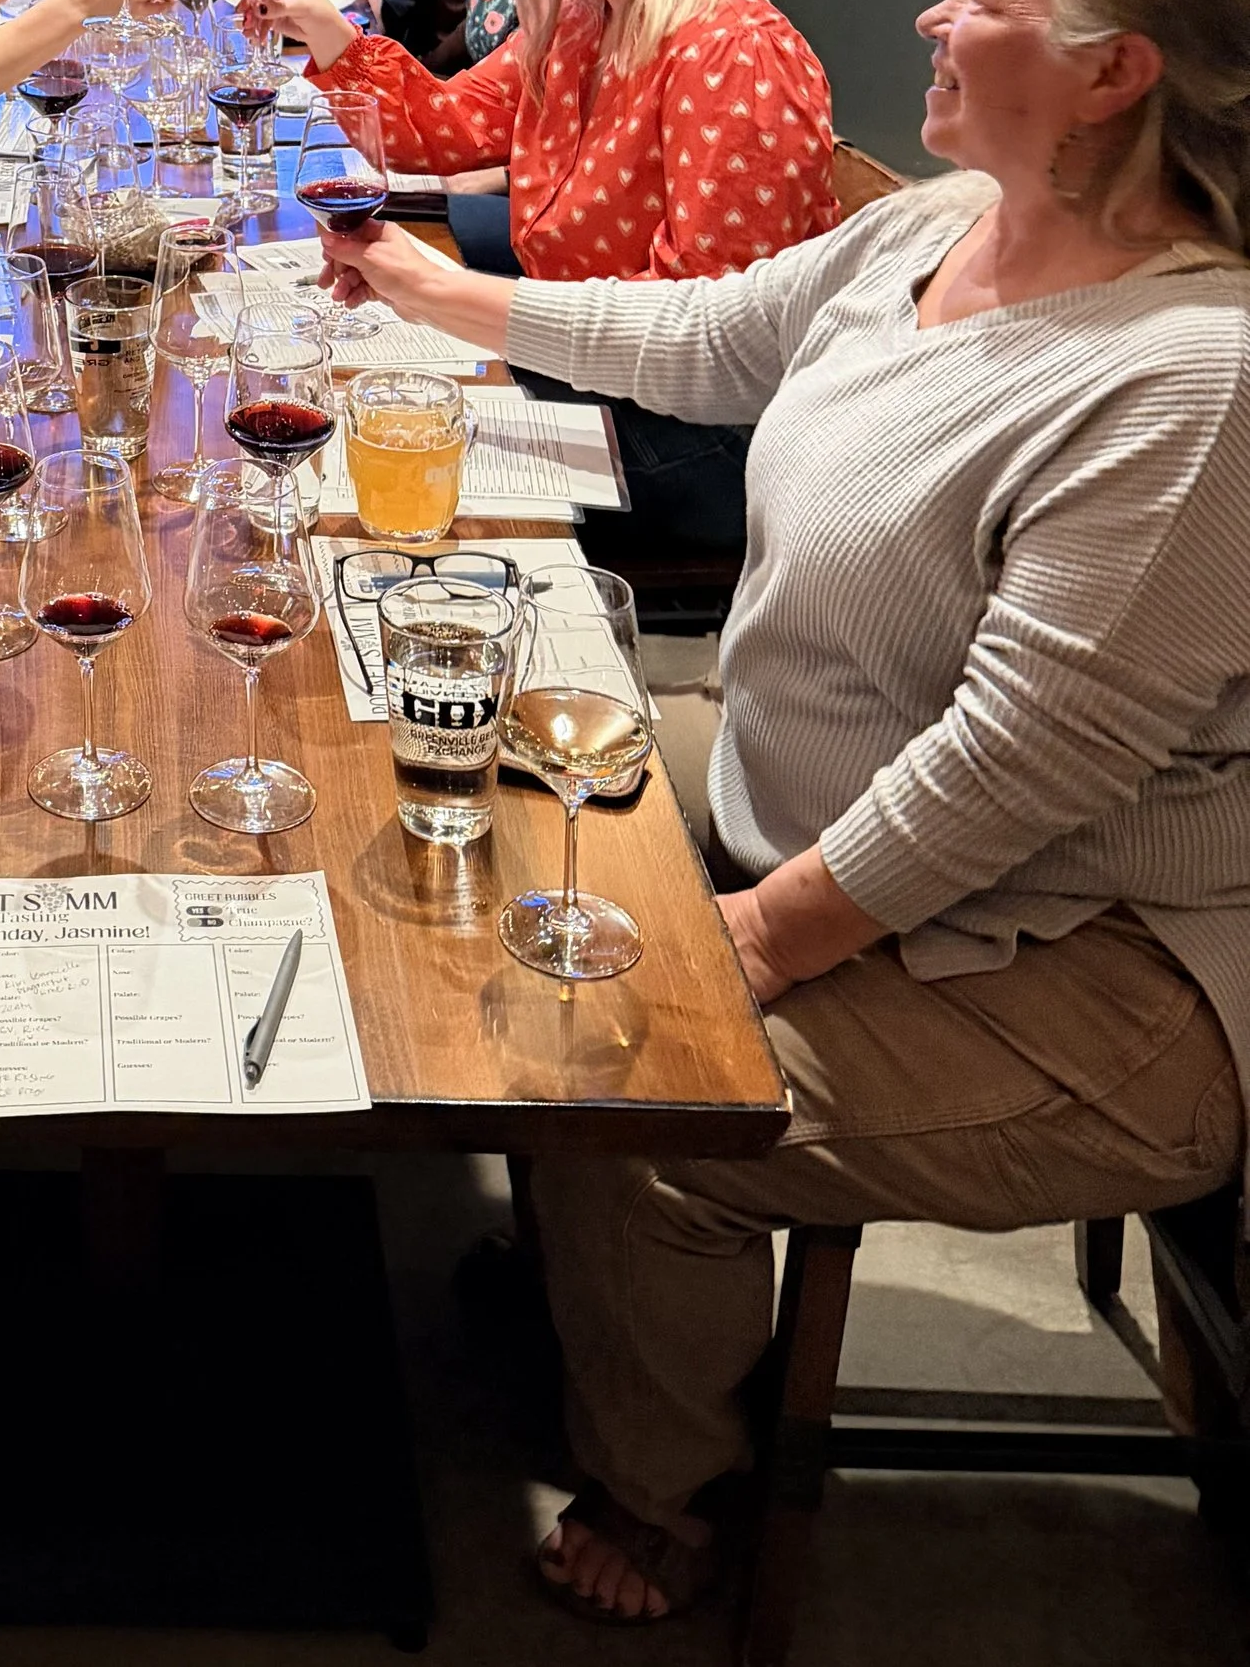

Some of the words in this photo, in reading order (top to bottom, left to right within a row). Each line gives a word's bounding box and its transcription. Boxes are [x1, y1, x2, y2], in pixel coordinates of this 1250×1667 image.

[410, 728, 477, 746] GREENVILLE
[427, 743, 488, 757] EXCHANGE
[225, 892, 277, 901] BUBBLES
[226, 906, 258, 916] True
[228, 916, 313, 928] Champagne?
[54, 924, 151, 941] Jasmine!
[28, 1015, 62, 1023] Grapes?
[149, 1014, 183, 1022] Grapes?
[51, 1038, 90, 1046] Modern?
